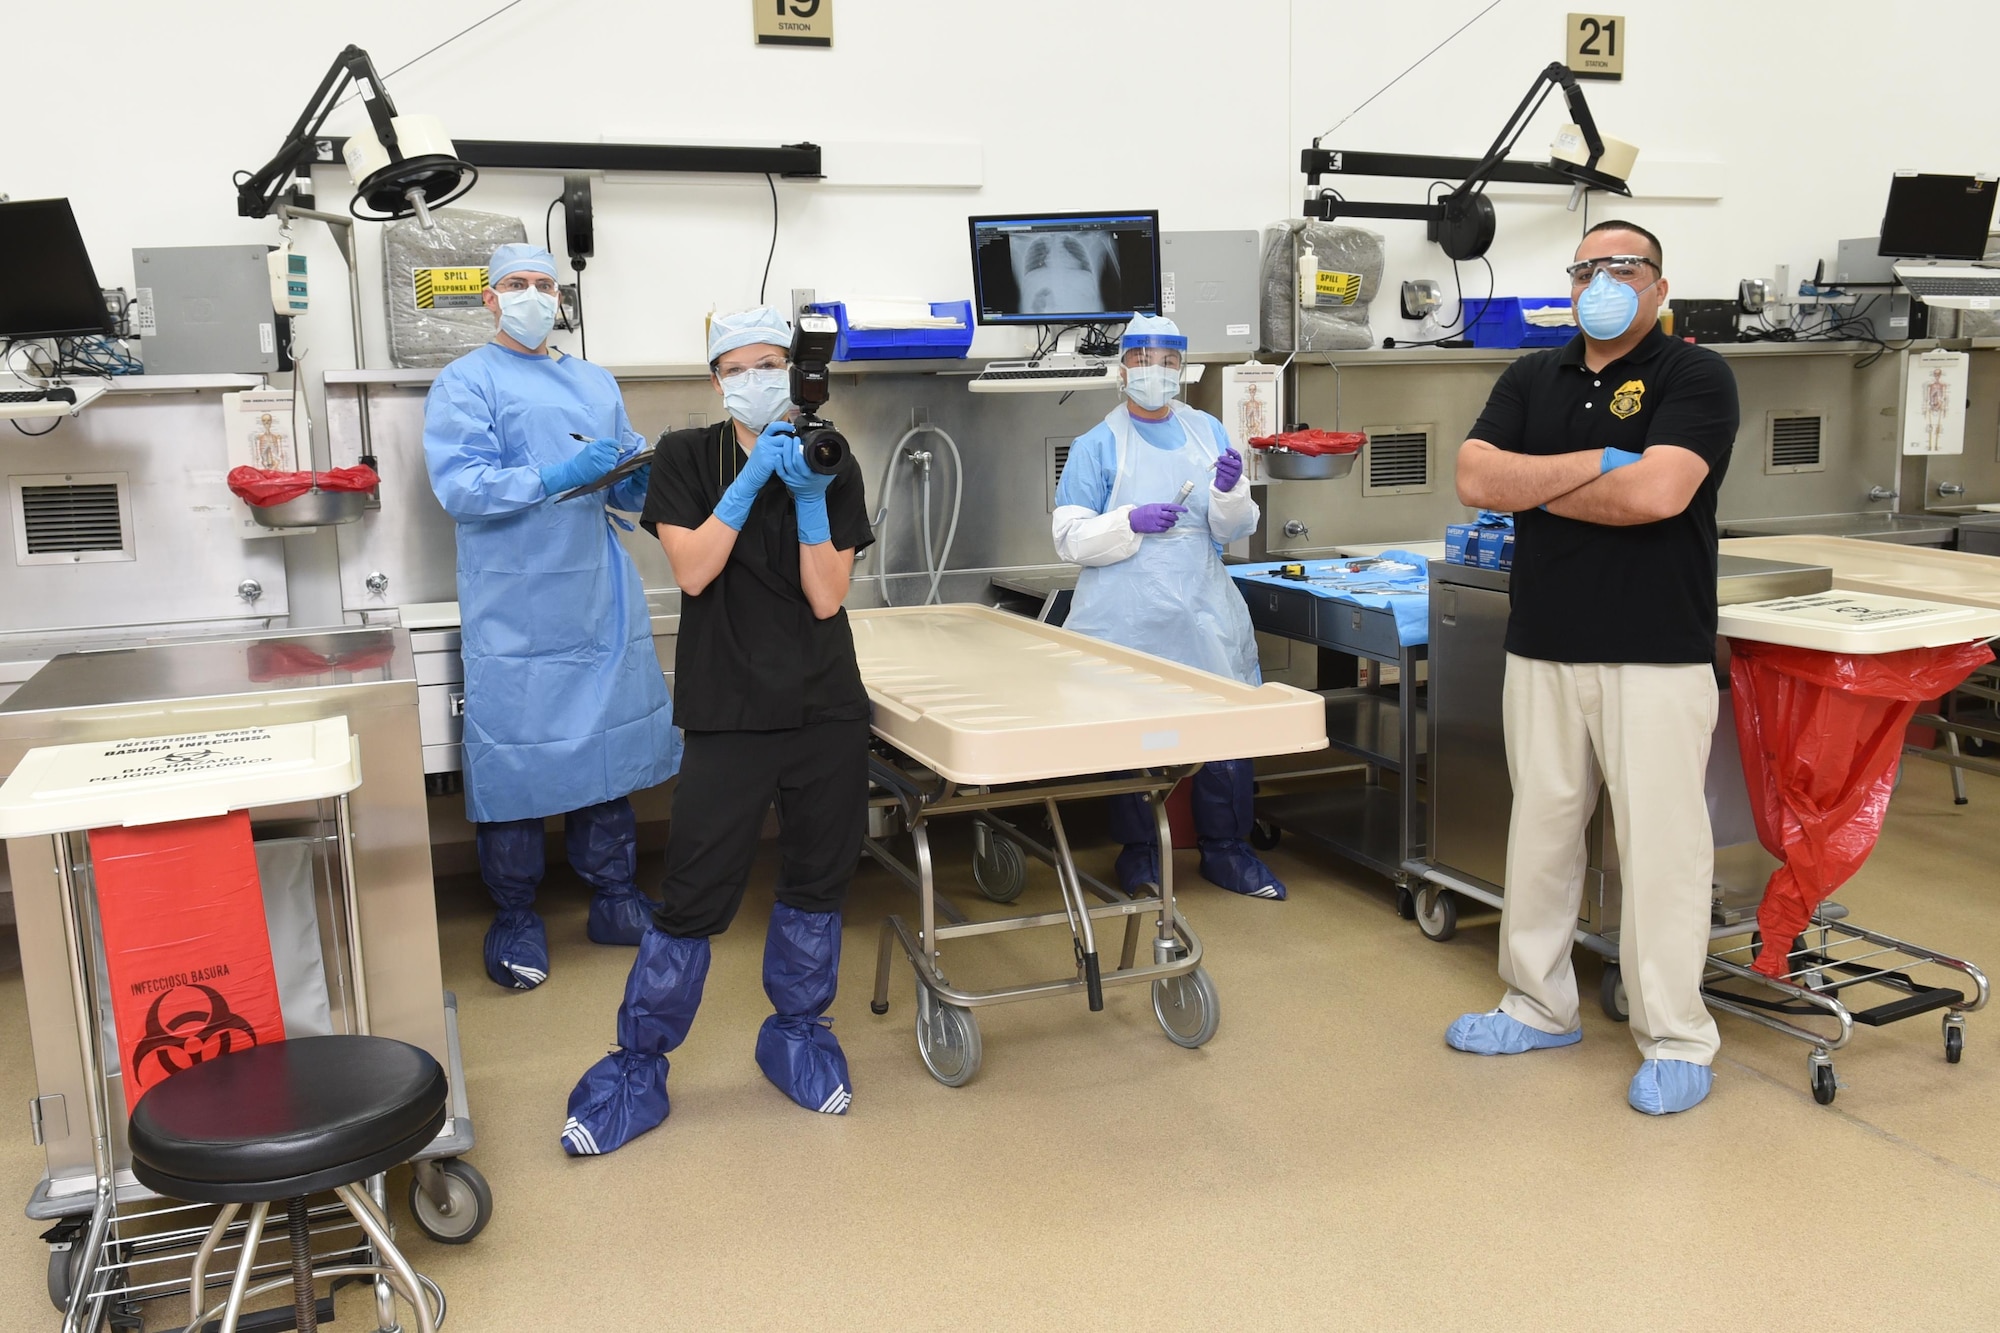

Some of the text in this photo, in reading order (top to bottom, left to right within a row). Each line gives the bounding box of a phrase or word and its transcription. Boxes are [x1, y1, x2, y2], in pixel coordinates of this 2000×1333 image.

[778, 22, 811, 31] STATION
[1579, 18, 1615, 56] 21
[1585, 60, 1608, 68] STATION
[444, 271, 468, 281] SPILL
[1320, 274, 1339, 283] SPILL
[434, 284, 467, 292] RESPONSE
[103, 734, 272, 757] BASURA INFECCIOSA
[115, 734, 208, 749] INFECTIOUS
[88, 757, 272, 783] PELIGRO BIOLOGICO
[122, 755, 245, 774] BIO-HAZARD
[130, 964, 230, 996] INFECCIOSO BASURA
